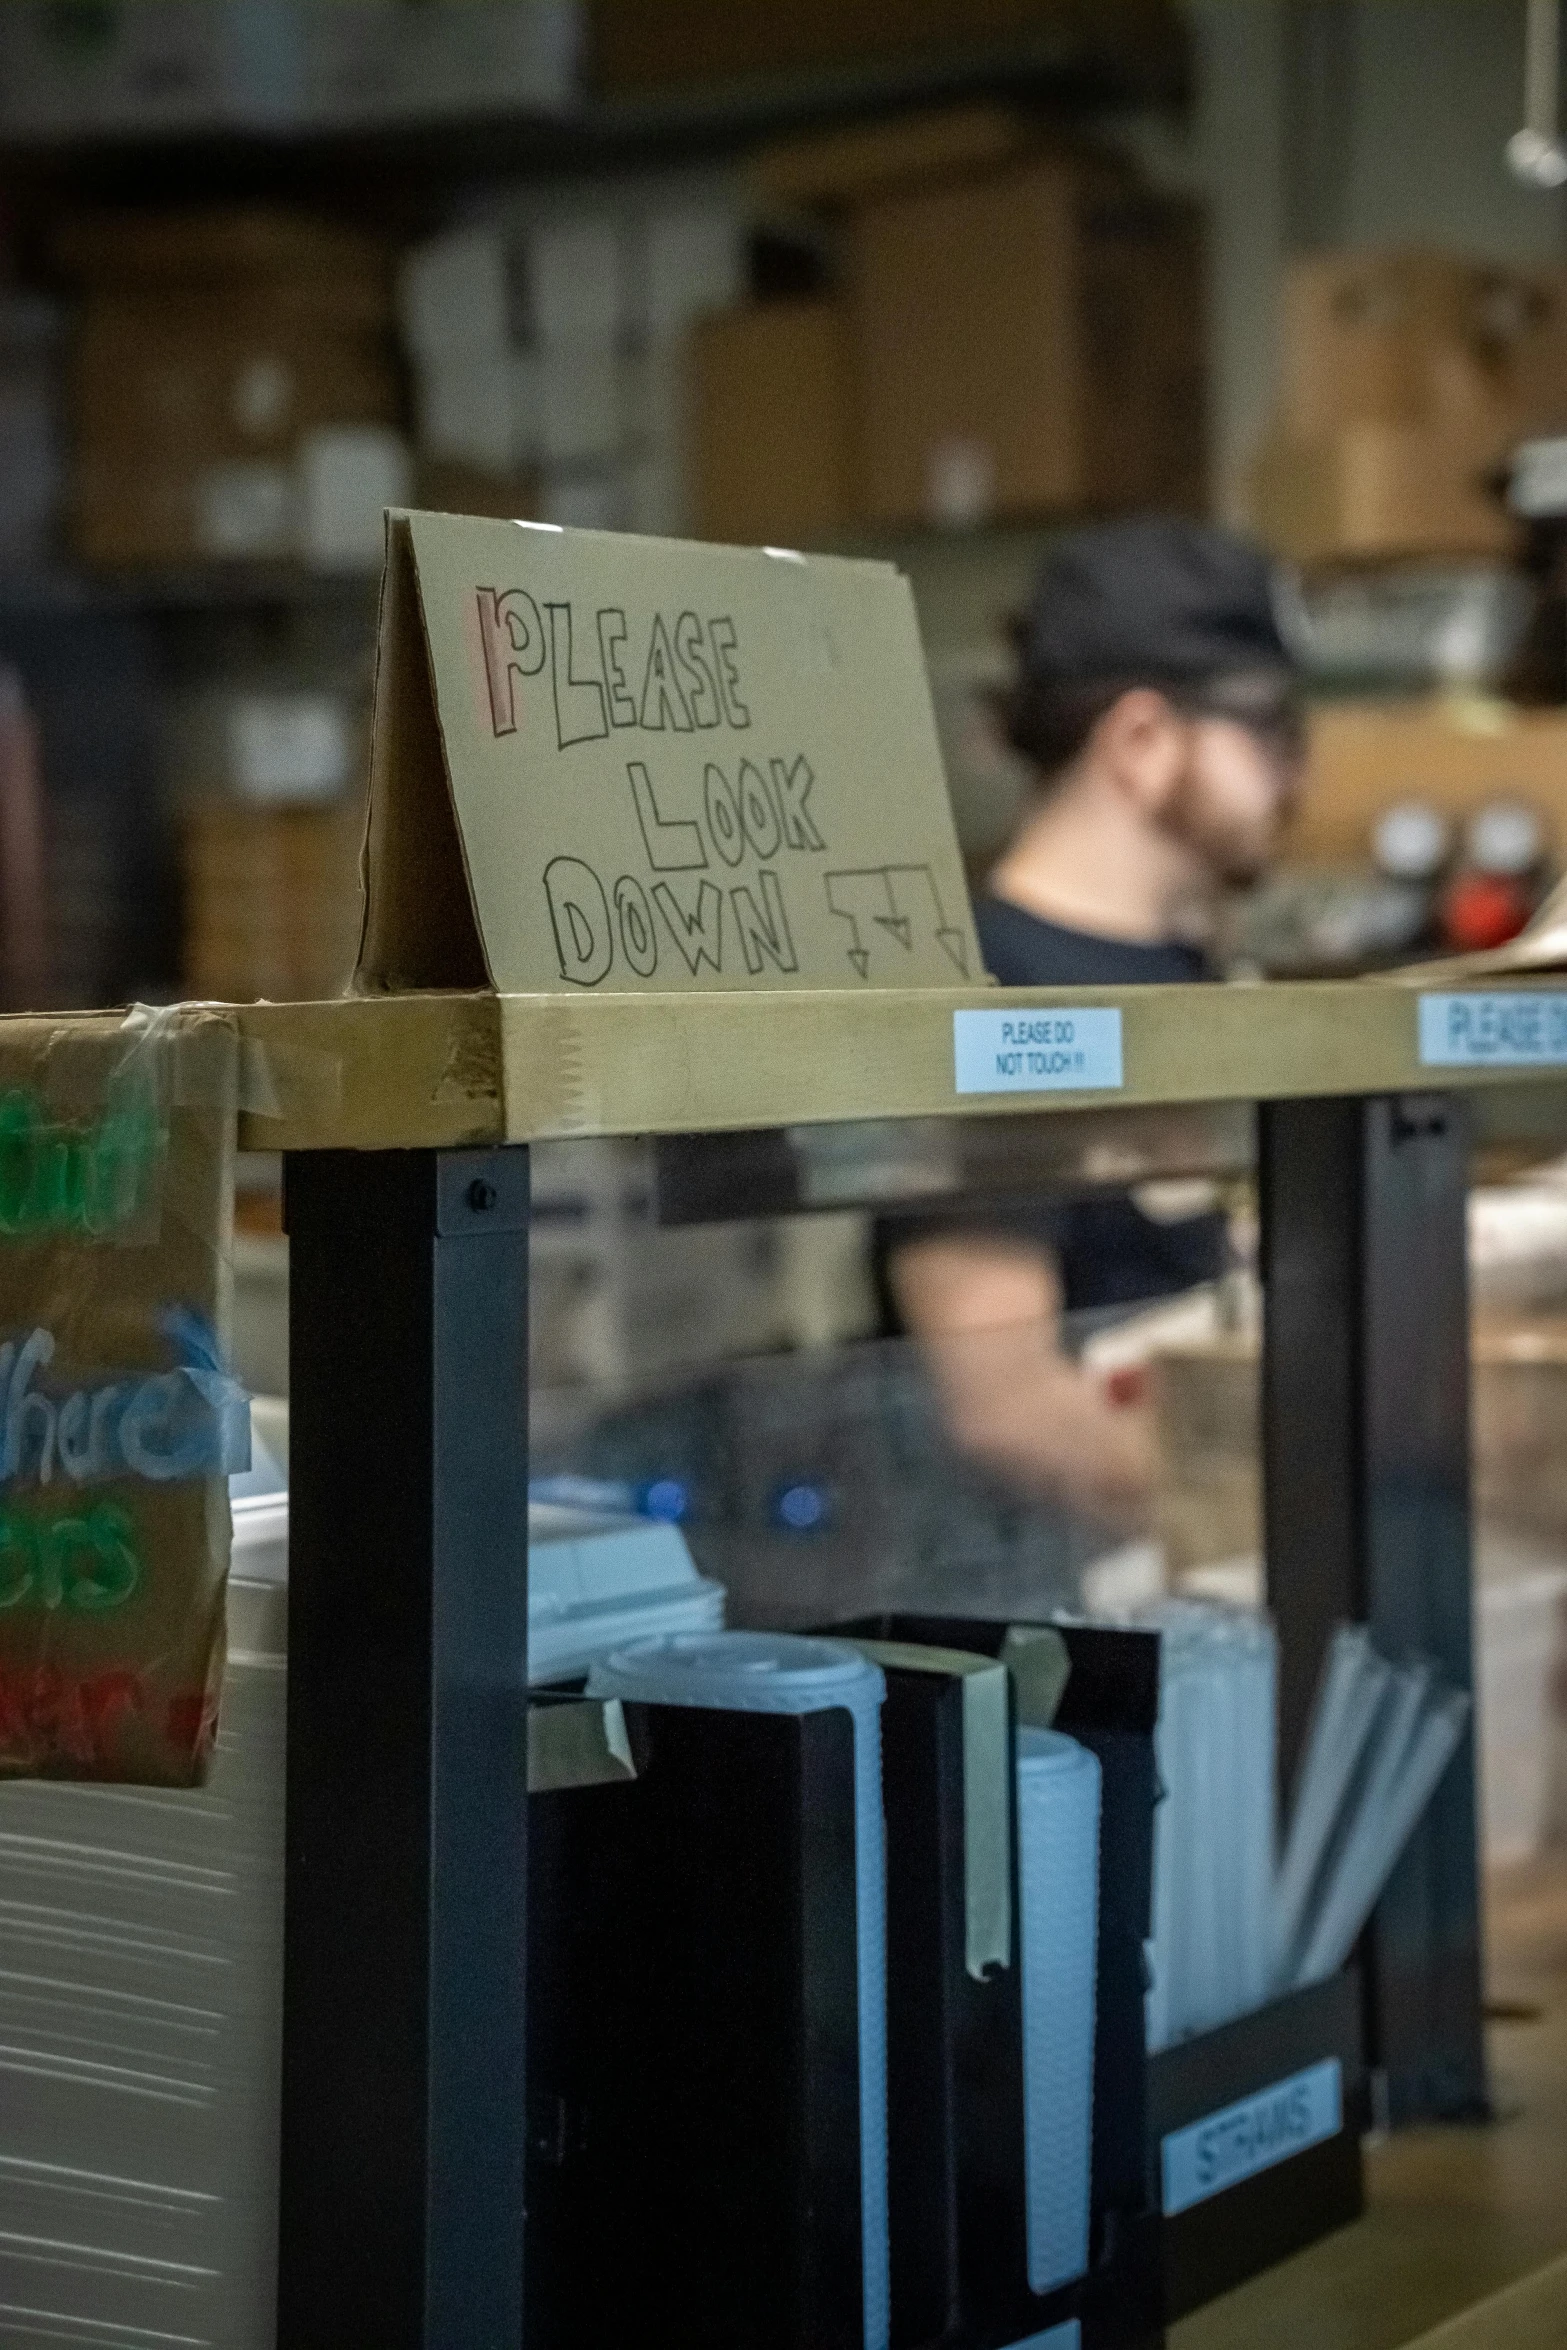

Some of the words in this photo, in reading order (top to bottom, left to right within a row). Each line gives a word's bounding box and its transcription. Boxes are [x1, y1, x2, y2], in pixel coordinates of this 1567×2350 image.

[475, 585, 751, 752] PLEASE
[626, 753, 826, 872] LOOK
[542, 855, 799, 987] DOWN
[995, 1051, 1023, 1075] NOT
[1026, 1050, 1072, 1075] TOUCH
[1002, 1020, 1052, 1045] PLEASE
[1054, 1019, 1075, 1044] DO
